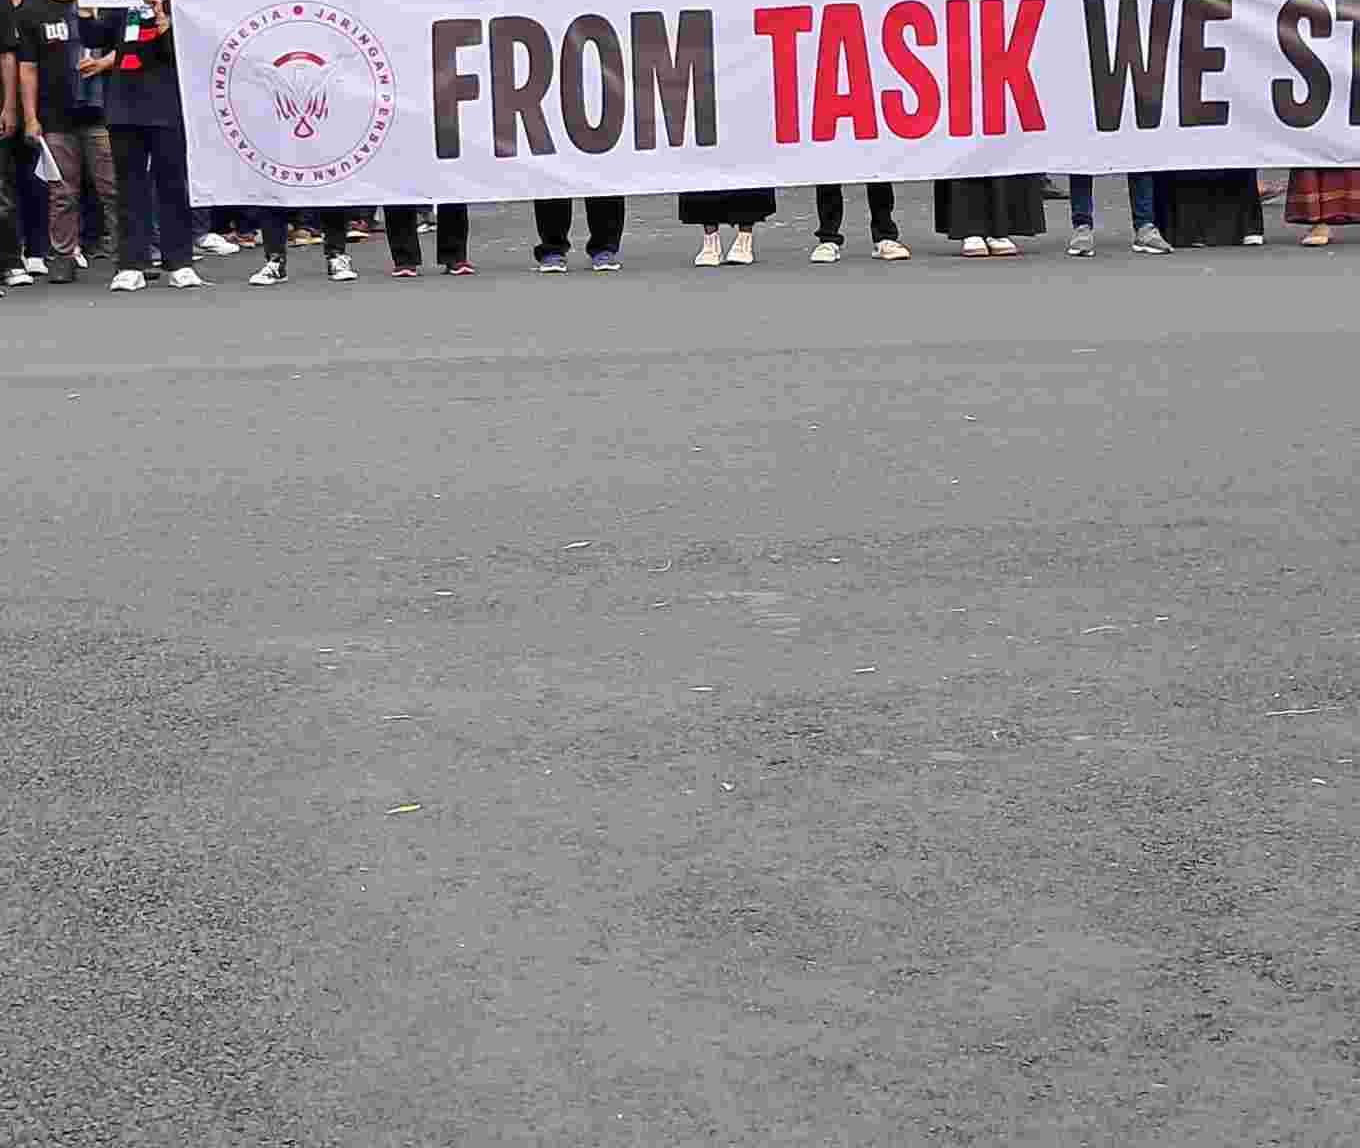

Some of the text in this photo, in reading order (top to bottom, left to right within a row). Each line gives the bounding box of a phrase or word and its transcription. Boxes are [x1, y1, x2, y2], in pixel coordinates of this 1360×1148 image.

[215, 7, 391, 182] JARINGAN PERSATUAN ASLI TASIK INDONESIA
[431, 8, 717, 160] FROM
